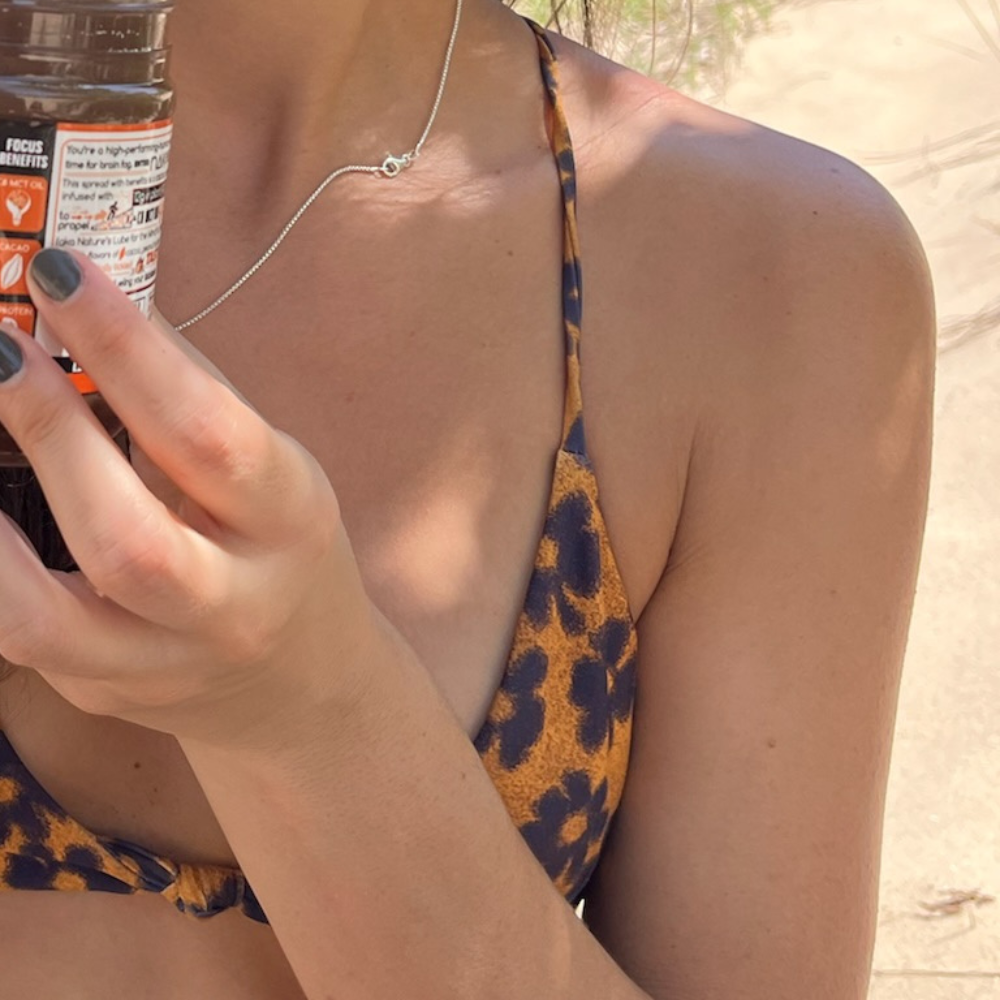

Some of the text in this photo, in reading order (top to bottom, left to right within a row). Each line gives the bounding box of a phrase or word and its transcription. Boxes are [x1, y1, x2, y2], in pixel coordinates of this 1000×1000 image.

[6, 138, 44, 154] FOCUS
[65, 161, 84, 169] time
[86, 160, 98, 168] for
[100, 160, 120, 169] brain
[9, 179, 29, 188] MCT
[30, 181, 45, 189] OIL
[63, 178, 79, 187] This
[81, 178, 109, 189] spread
[62, 191, 114, 200] infused with
[59, 211, 70, 220] to
